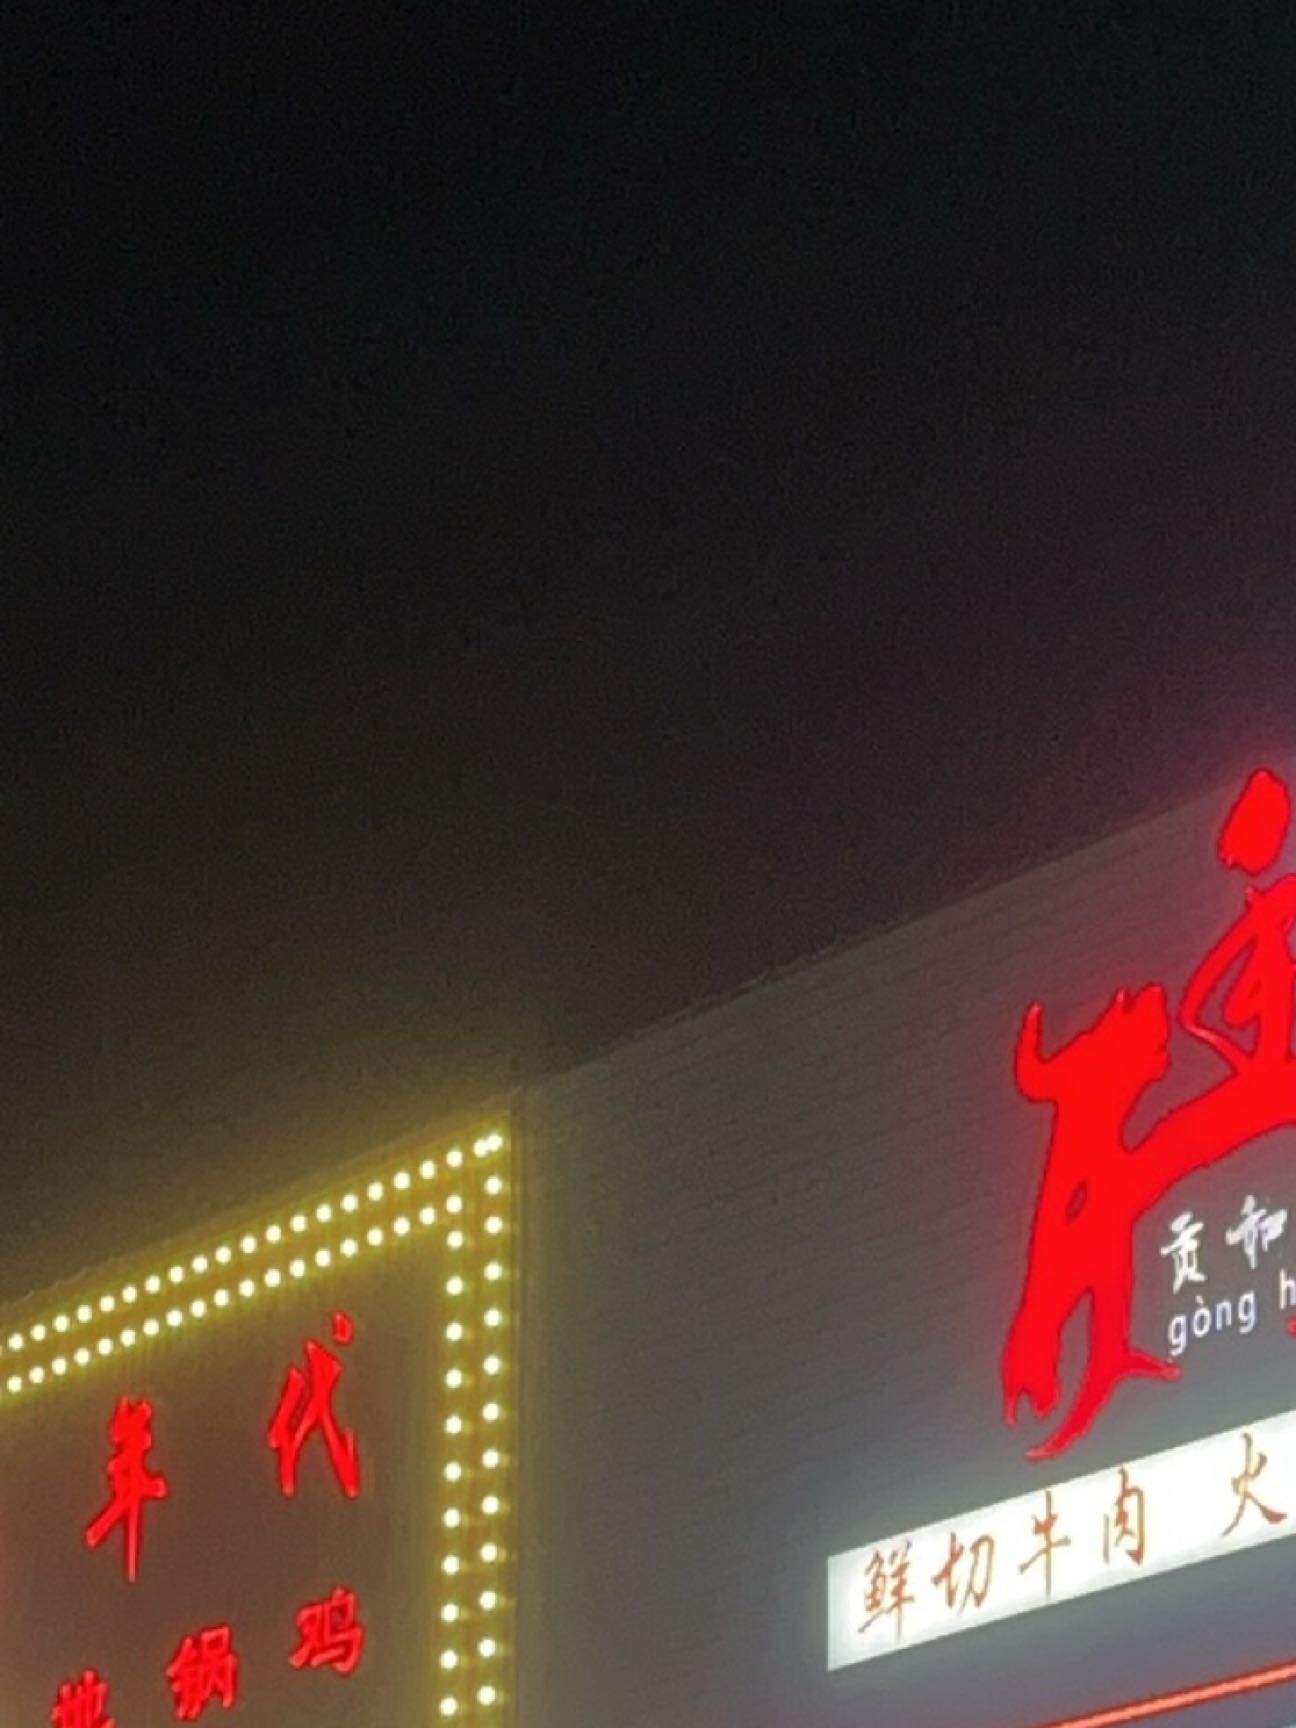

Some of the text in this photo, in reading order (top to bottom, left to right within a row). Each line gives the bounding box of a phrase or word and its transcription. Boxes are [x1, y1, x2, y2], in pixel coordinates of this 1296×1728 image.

[1168, 1290, 1258, 1356] gòng
[85, 1310, 362, 1583] 年代
[857, 1466, 1148, 1642] 鲜切牛肉
